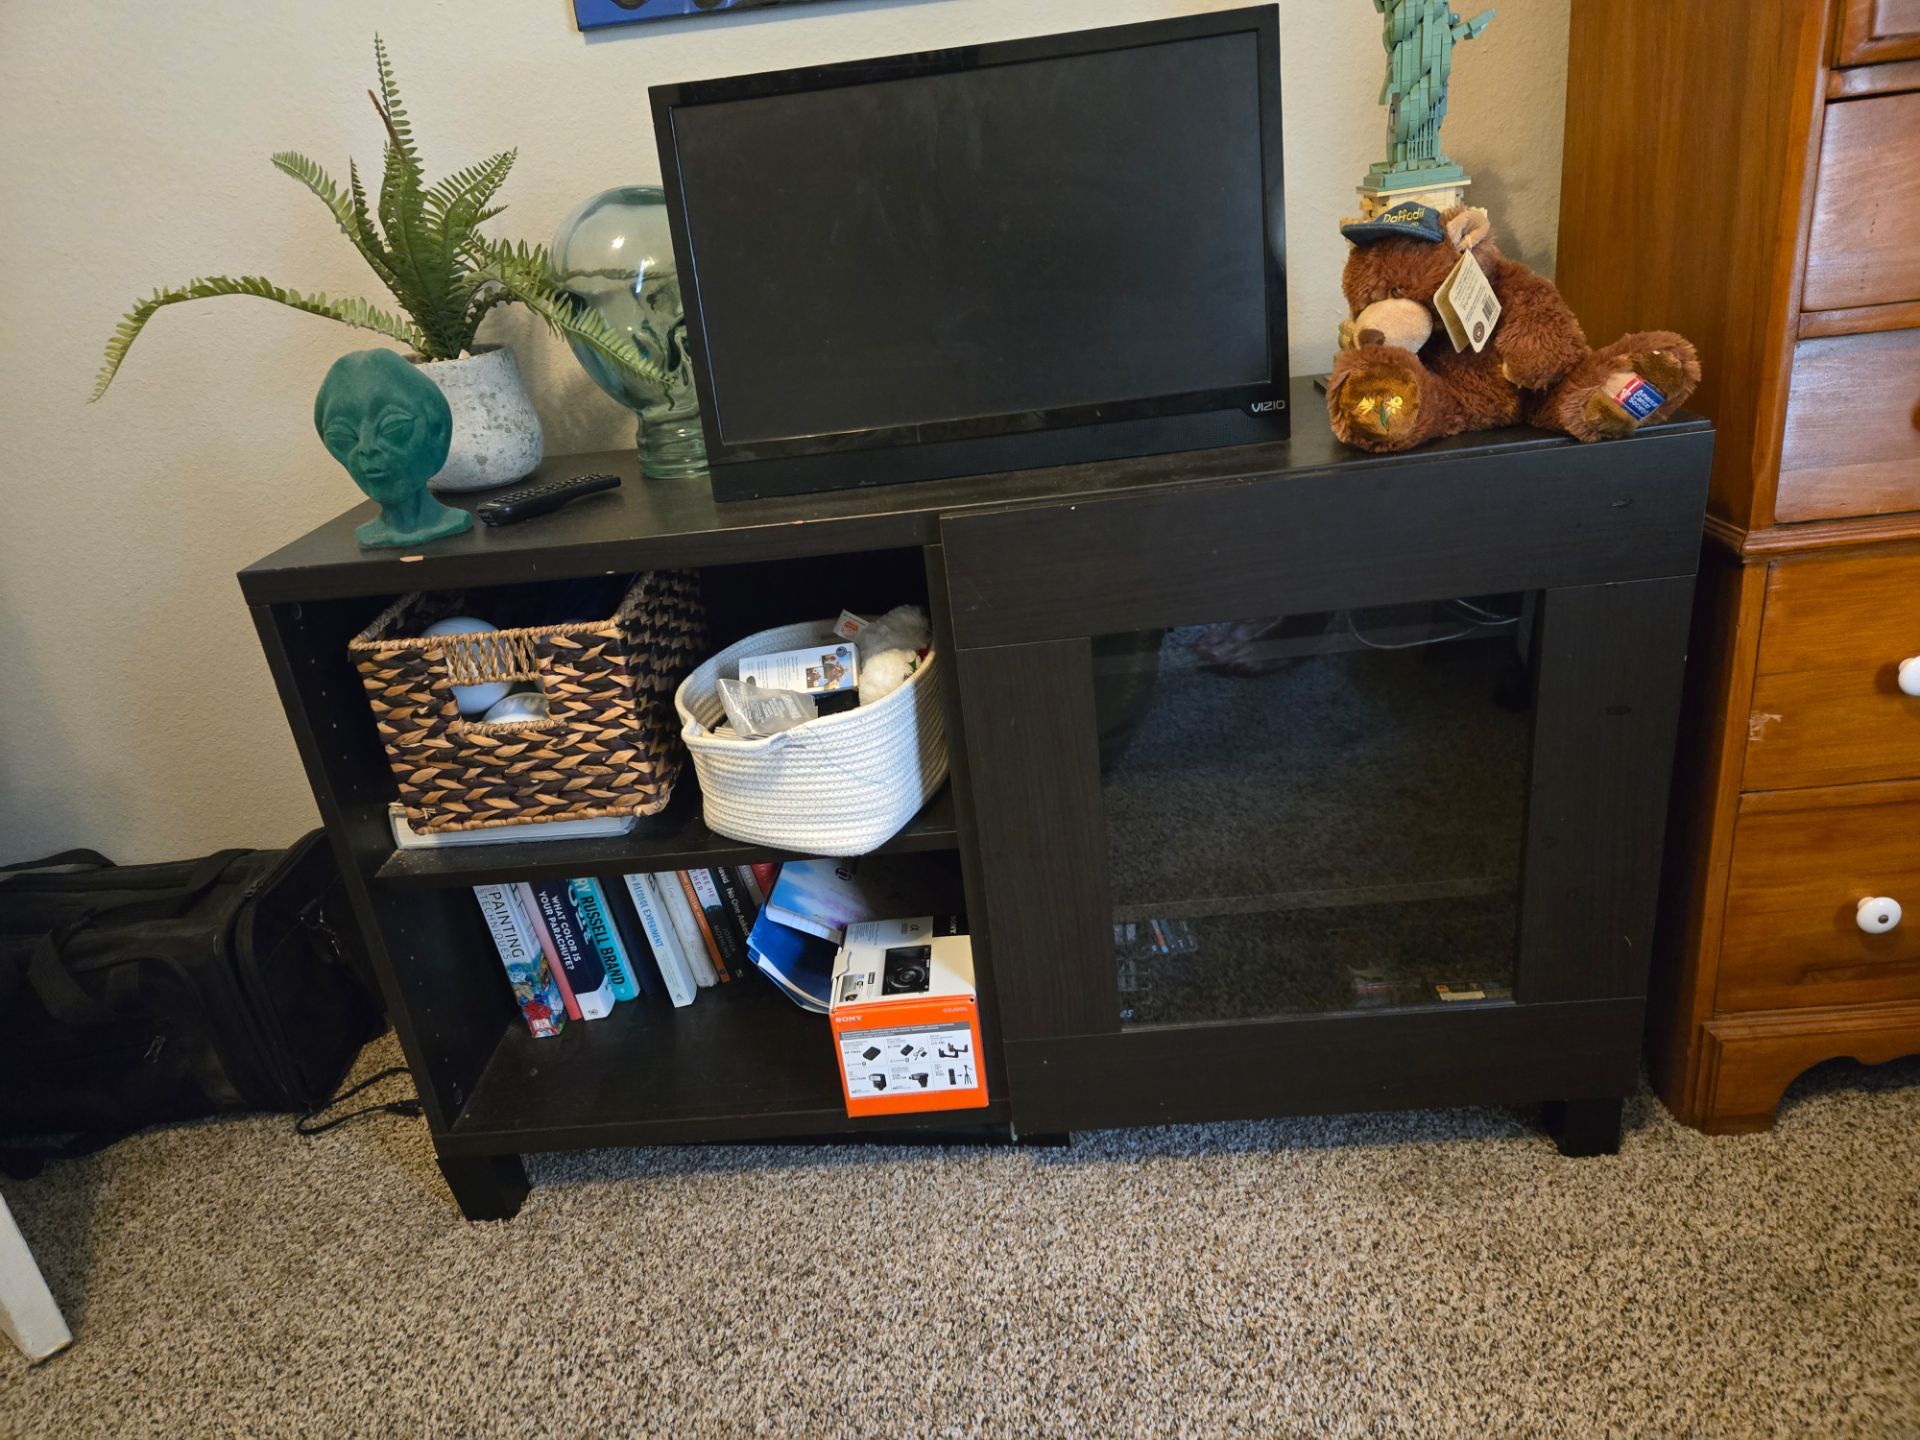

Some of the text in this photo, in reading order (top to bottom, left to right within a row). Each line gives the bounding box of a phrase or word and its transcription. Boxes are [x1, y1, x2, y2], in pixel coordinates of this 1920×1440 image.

[1383, 207, 1425, 223] Daffodil
[1251, 400, 1286, 412] VIZIO
[488, 891, 525, 958] PAINTING
[726, 887, 735, 899] No
[731, 898, 741, 914] One
[479, 895, 511, 960] TECHNIQUES
[539, 890, 575, 970] YOUR PARACHUTE?
[551, 895, 566, 920] WHAT
[561, 922, 577, 952] COLOR
[572, 953, 582, 962] IS
[580, 895, 609, 945] RUSSELL
[600, 946, 625, 985] BRAND
[643, 908, 664, 948] EXPERIMENT
[835, 1015, 863, 1023] SONY
